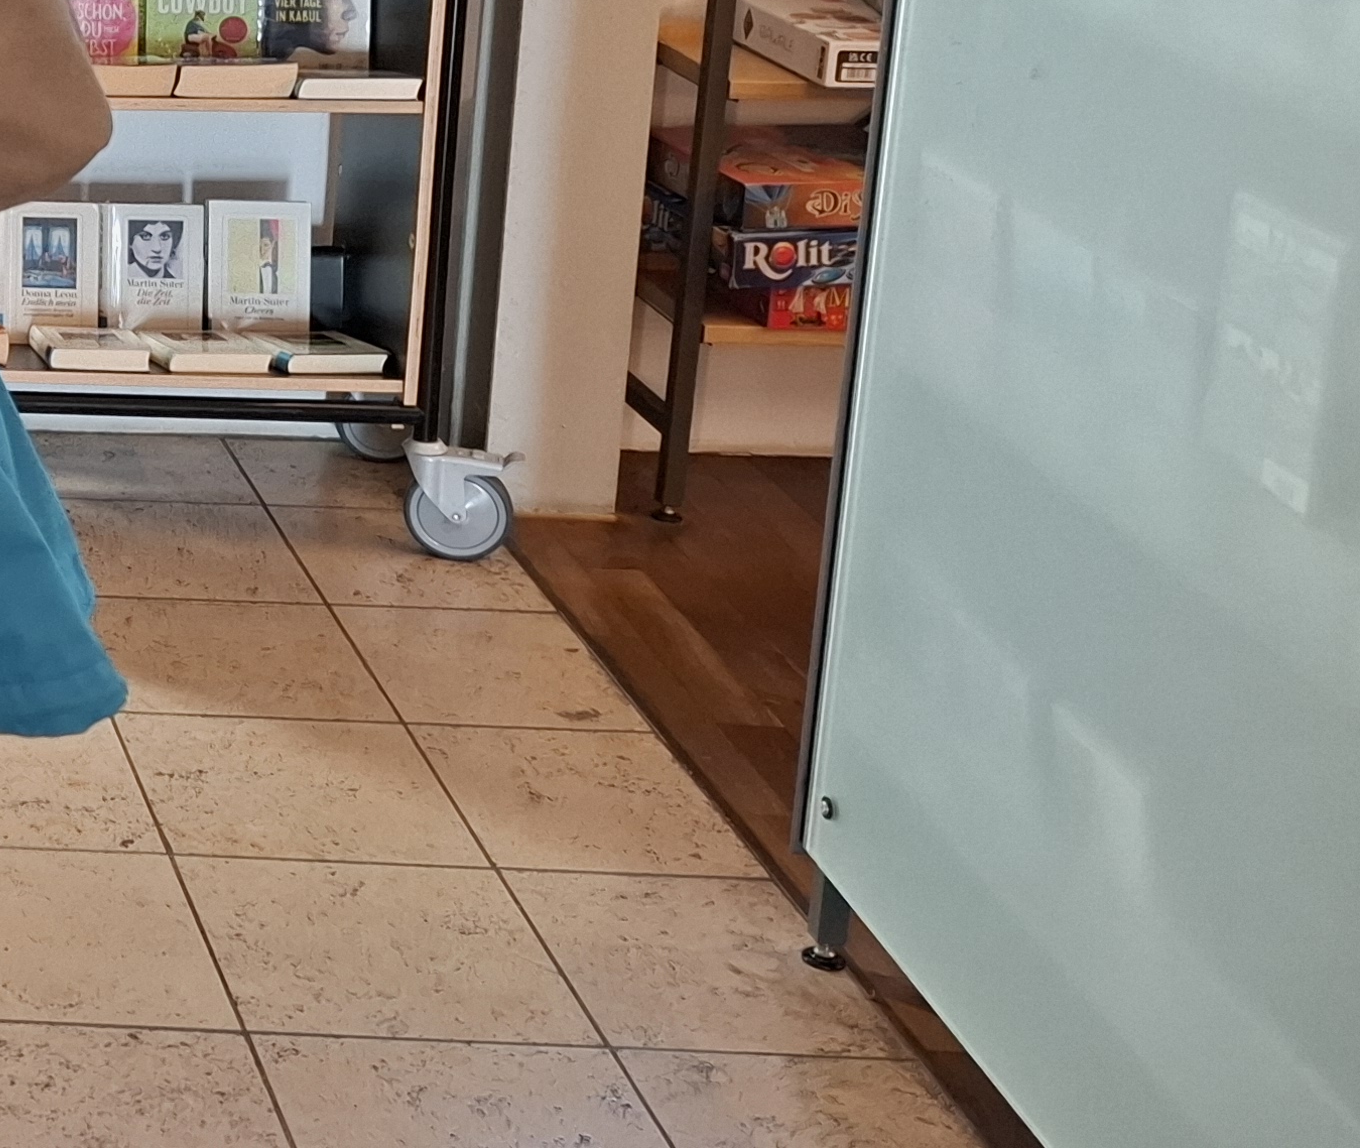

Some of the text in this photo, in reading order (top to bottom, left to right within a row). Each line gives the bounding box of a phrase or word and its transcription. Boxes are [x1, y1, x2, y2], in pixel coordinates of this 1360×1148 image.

[77, 2, 128, 22] SCHON,
[275, 9, 322, 24] IN KABUL
[80, 20, 102, 38] DU
[743, 239, 833, 281] Rolit
[127, 279, 185, 289] Martin Suter
[21, 289, 78, 299] Donna Leon
[136, 288, 153, 298] Die
[152, 297, 172, 307] Zeit
[229, 295, 290, 308] Martin Suter
